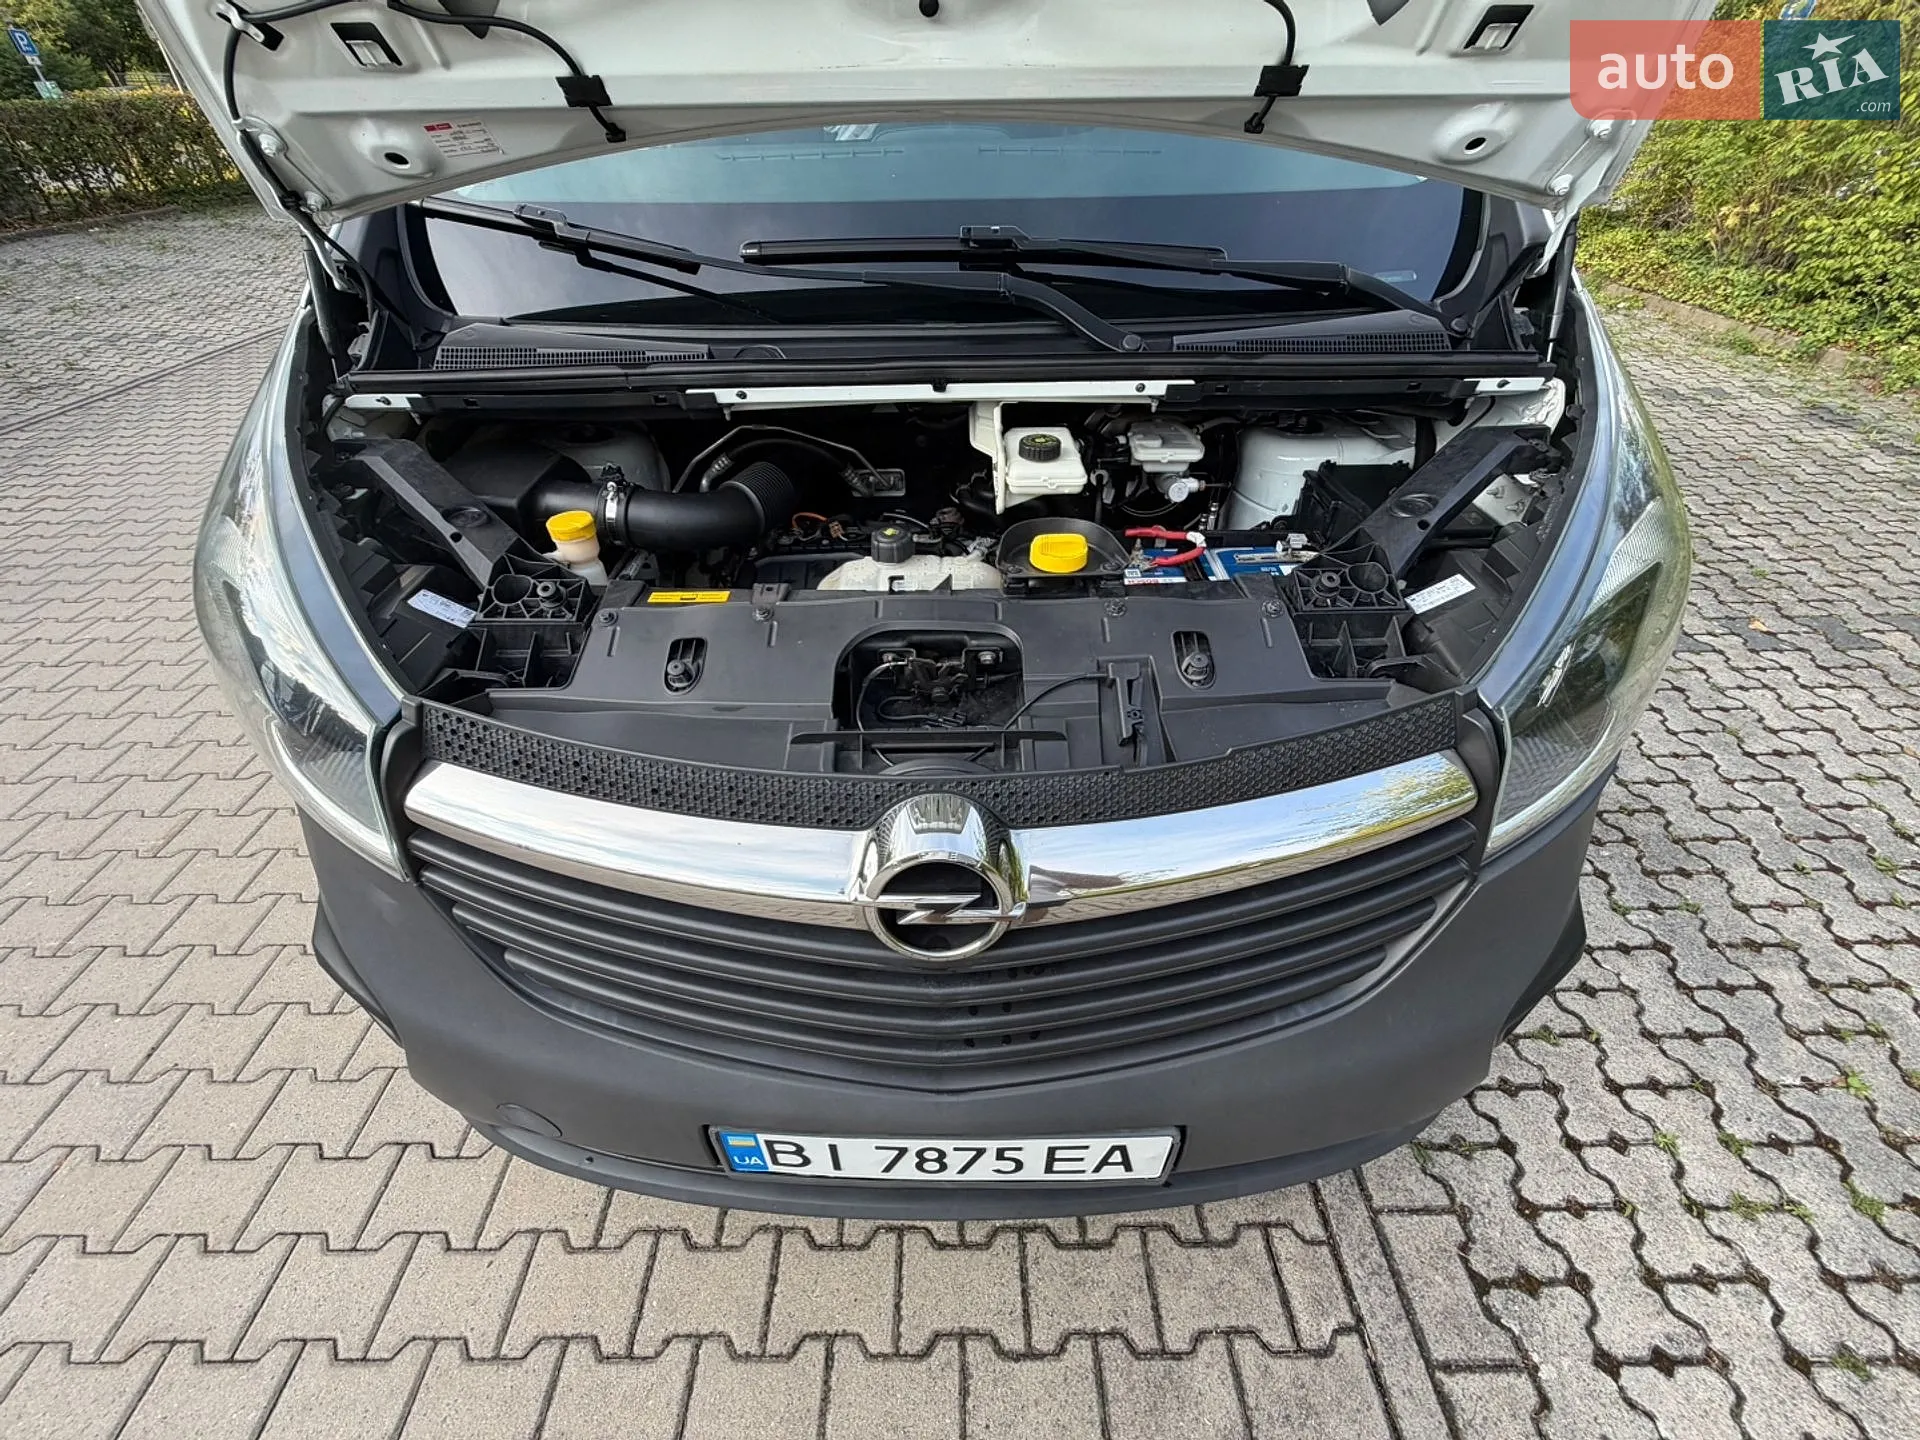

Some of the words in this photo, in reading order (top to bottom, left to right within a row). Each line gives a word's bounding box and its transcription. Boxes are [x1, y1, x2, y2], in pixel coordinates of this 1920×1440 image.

[733, 1155, 764, 1165] UA
[874, 1146, 1024, 1175] 7875
[1044, 1145, 1133, 1174] EA
